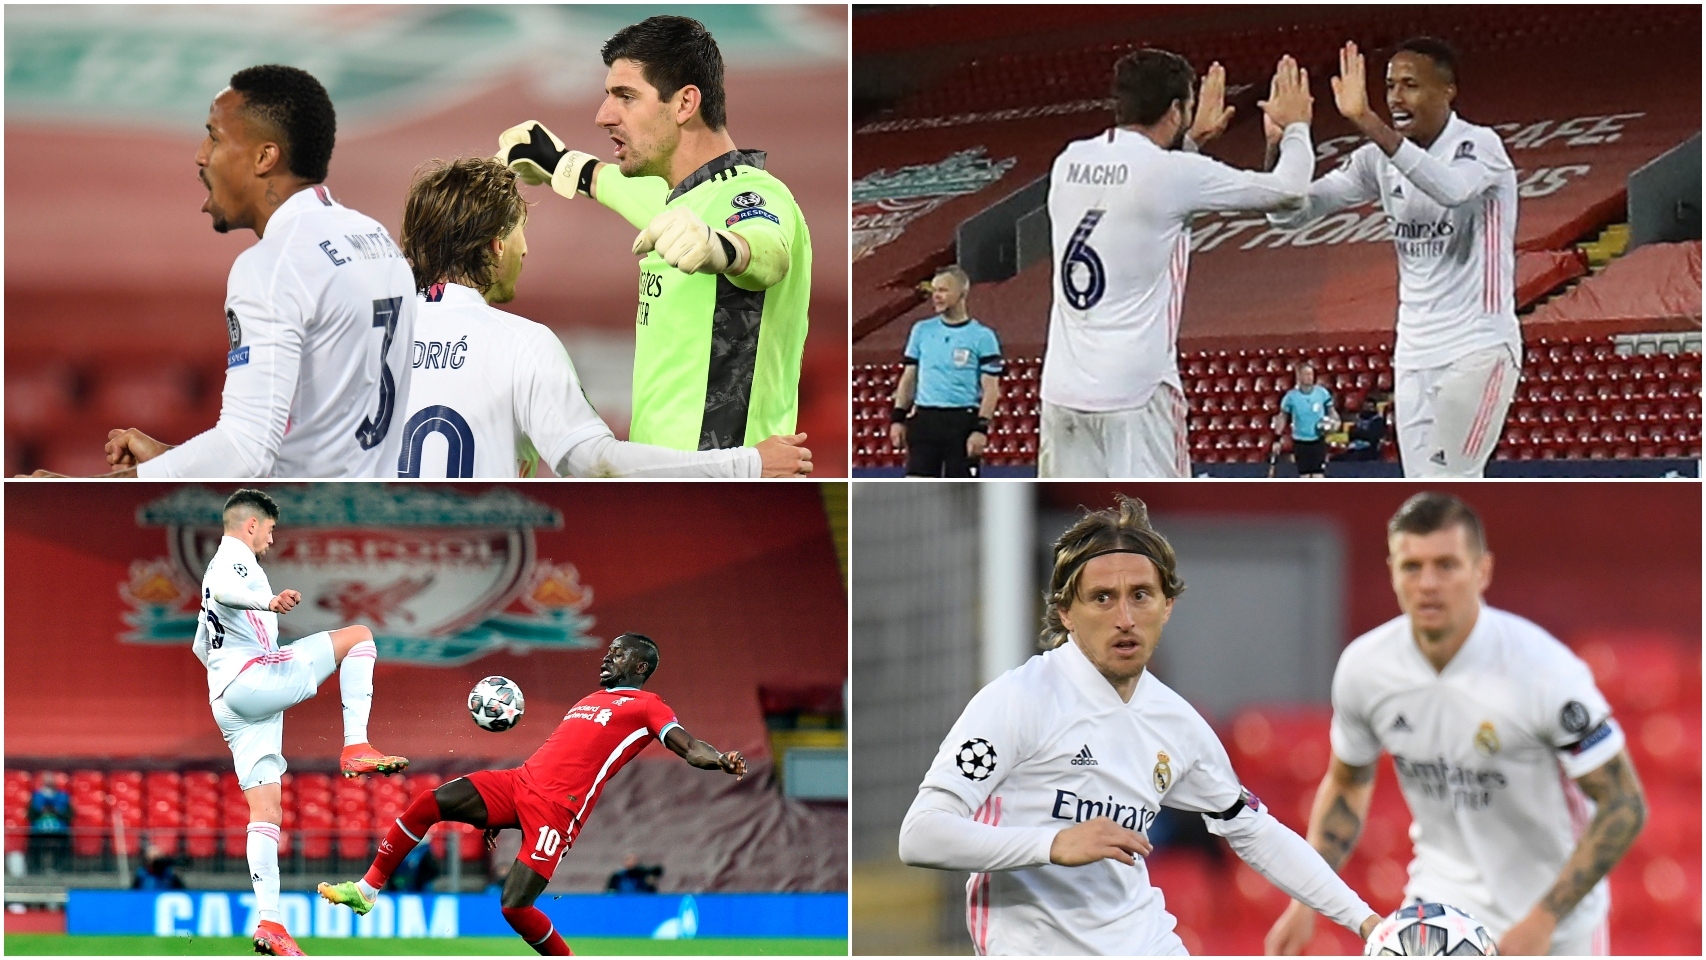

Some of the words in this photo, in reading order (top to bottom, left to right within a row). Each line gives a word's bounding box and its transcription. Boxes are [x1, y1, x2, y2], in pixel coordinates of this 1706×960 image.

[1066, 163, 1129, 185] NACHO
[740, 209, 779, 223] RESPECT
[319, 239, 352, 267] E.
[1061, 209, 1107, 311] 6
[412, 335, 468, 369] DRIĆ
[355, 296, 403, 451] 3
[1070, 758, 1099, 766] adidas
[1051, 788, 1157, 833] Emirate
[535, 824, 561, 857] 10
